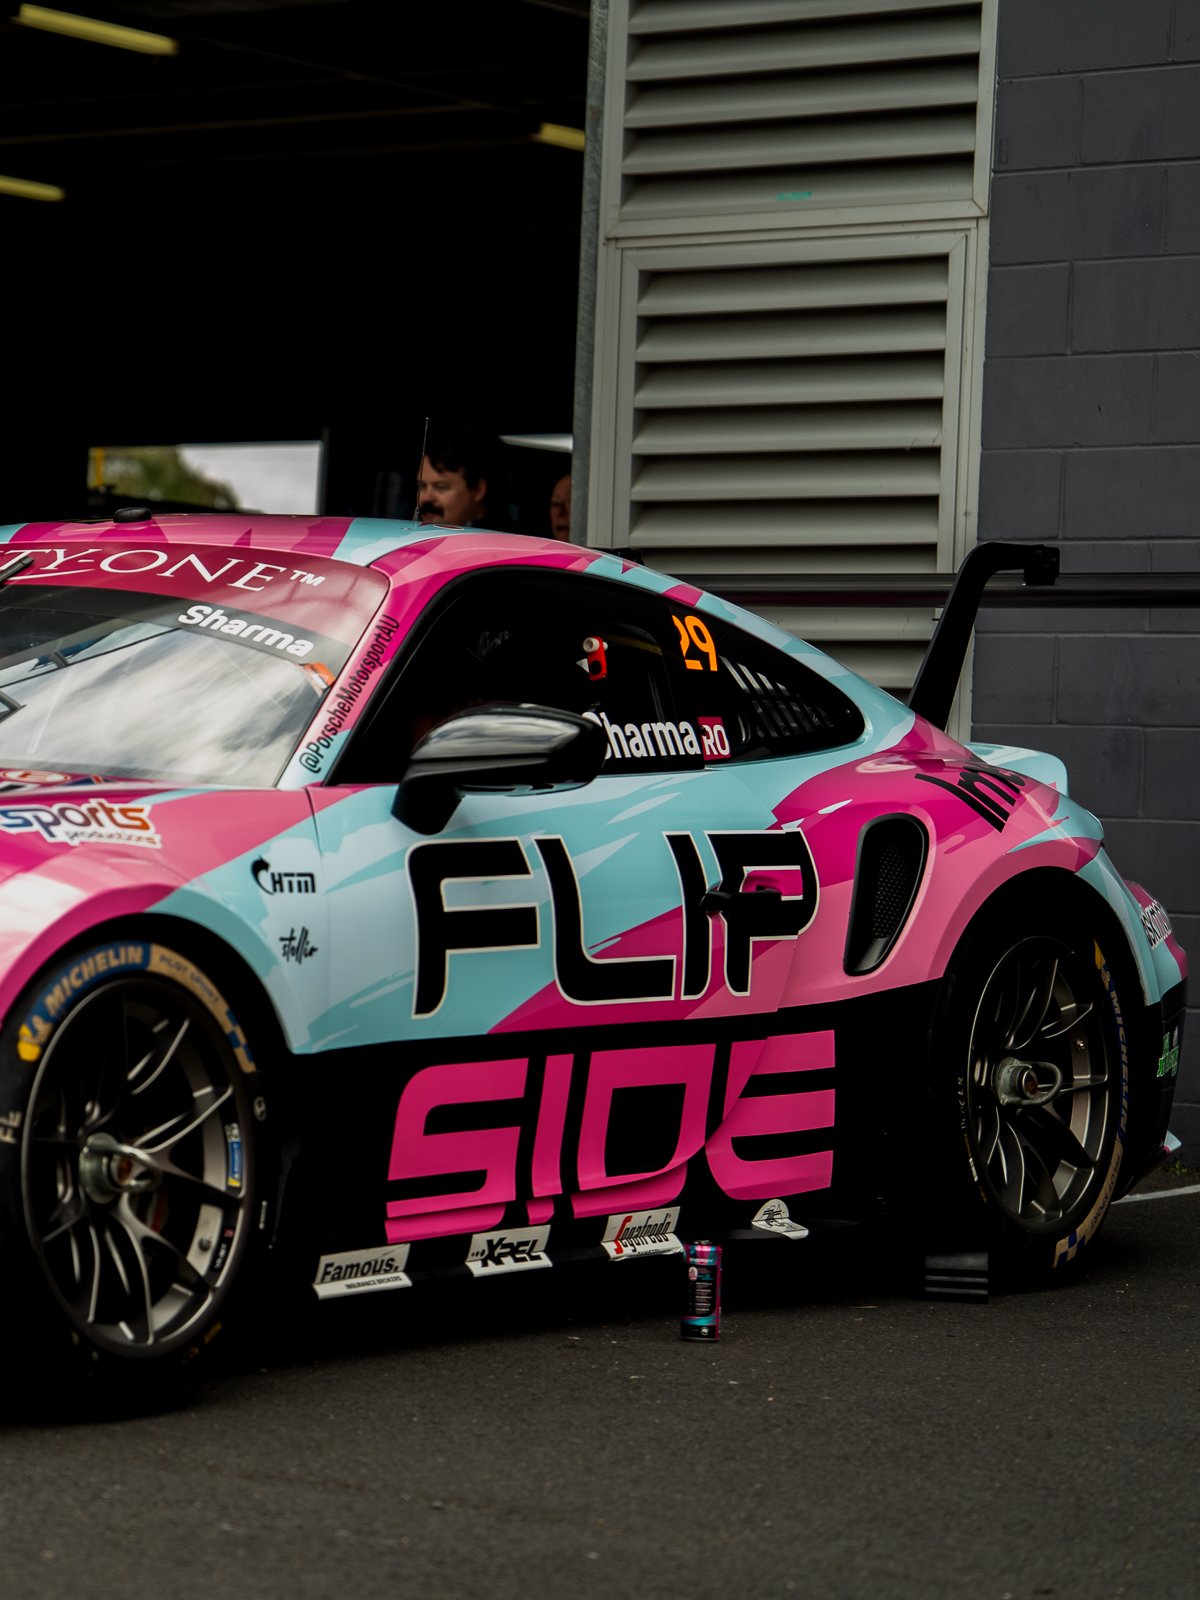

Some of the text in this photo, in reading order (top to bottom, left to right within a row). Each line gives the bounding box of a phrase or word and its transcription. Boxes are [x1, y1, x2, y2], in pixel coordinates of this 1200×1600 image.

[178, 605, 314, 657] Sharma
[672, 615, 719, 672] 29
[299, 614, 400, 774] @PorscheMotorsportAU
[405, 828, 820, 1020] FLIP
[43, 945, 144, 1015] MICHELIN
[384, 1029, 837, 1244] SIDE
[481, 1237, 542, 1268] XPEL
